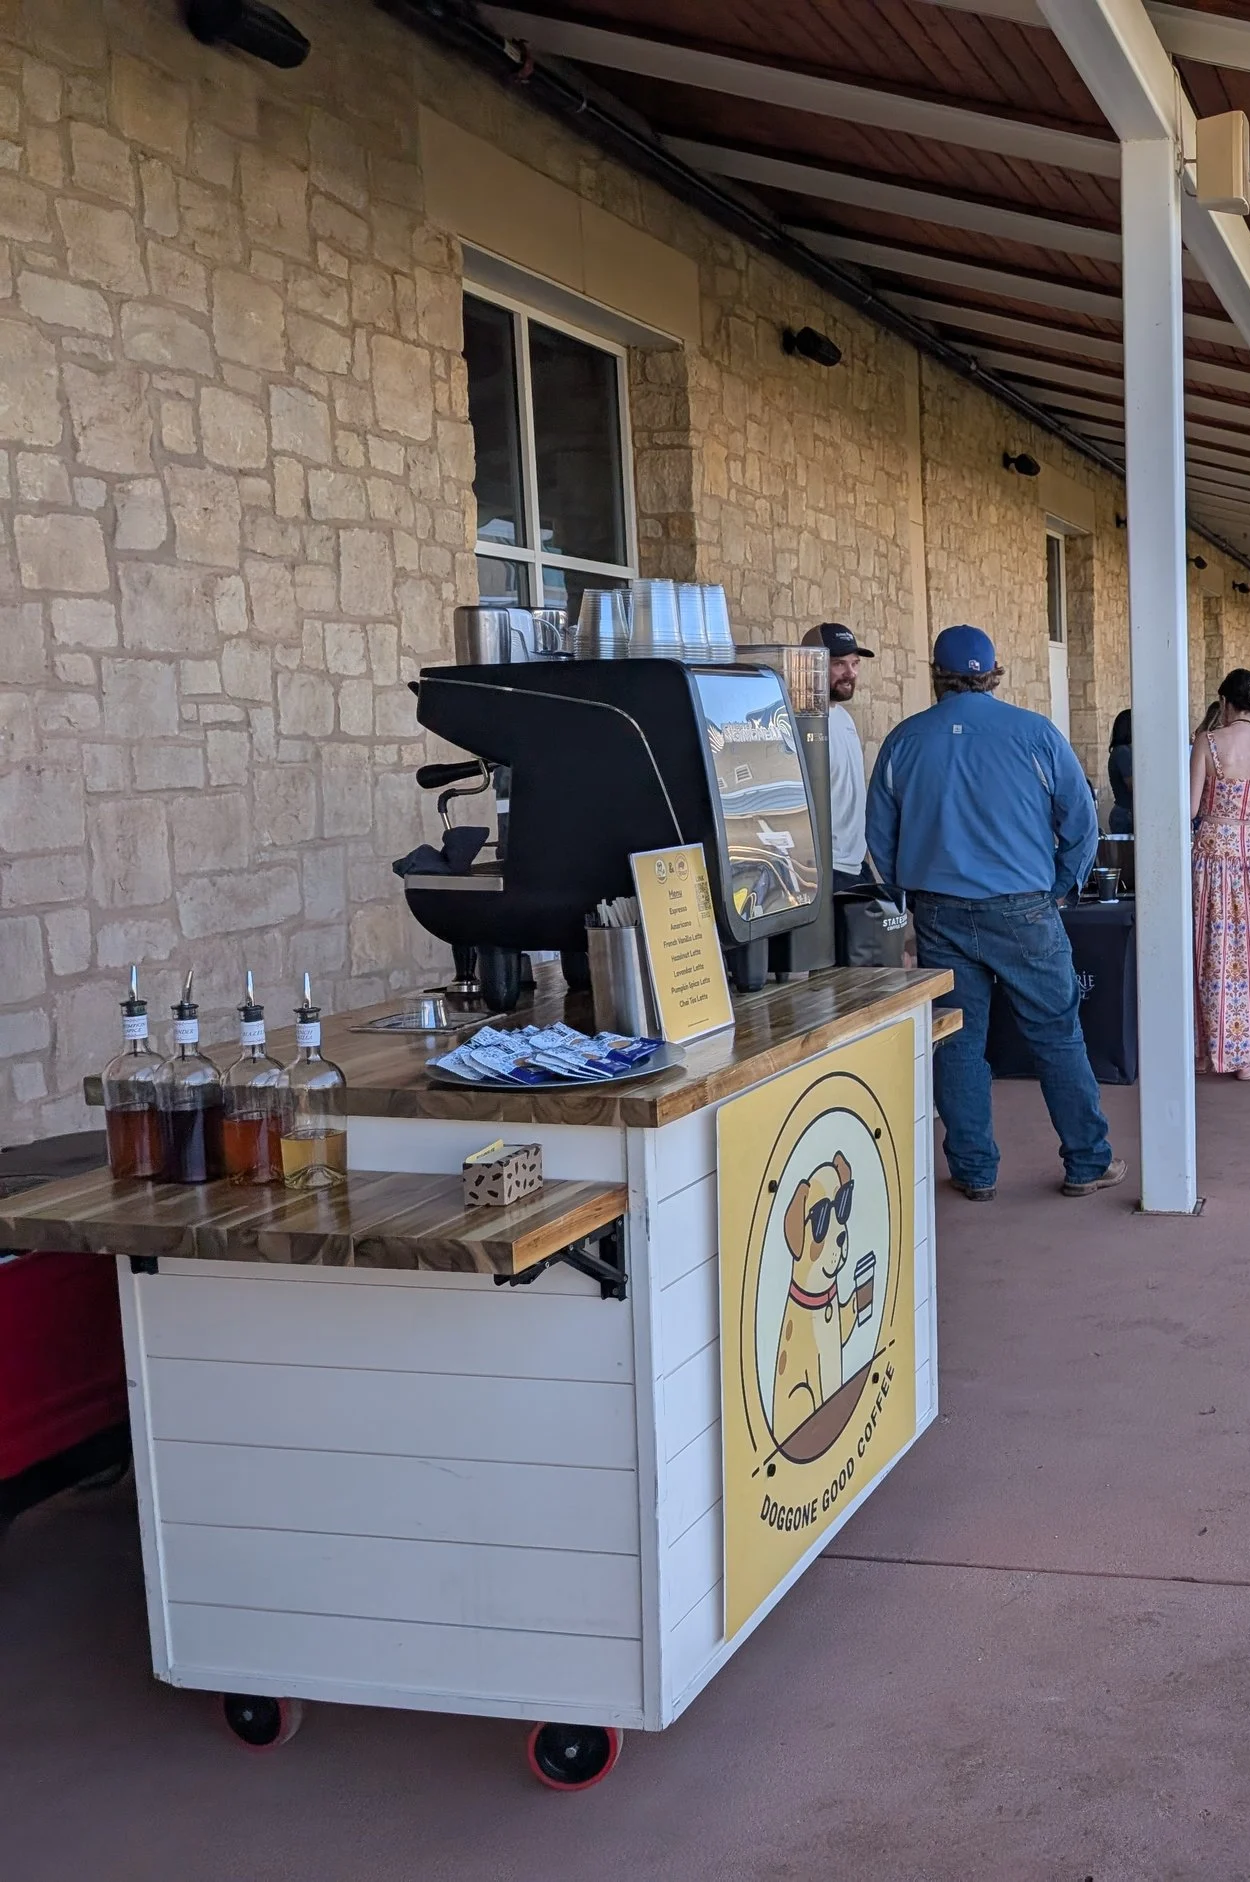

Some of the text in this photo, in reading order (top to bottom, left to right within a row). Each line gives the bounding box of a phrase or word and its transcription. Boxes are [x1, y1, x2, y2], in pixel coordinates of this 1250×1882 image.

[668, 889, 683, 900] Menu
[669, 906, 688, 916] Espresso
[670, 920, 692, 930] Americano
[663, 933, 703, 948] French Vanilla Latte
[671, 949, 702, 962] Hazelnut Latte
[673, 963, 704, 978] Lavender Latte
[671, 977, 711, 994] Pumpkin Spice Latte
[679, 999, 689, 1008] Chai
[696, 993, 708, 1002] Latte
[760, 1361, 895, 1532] DOGGONE GOOD COFFEE
